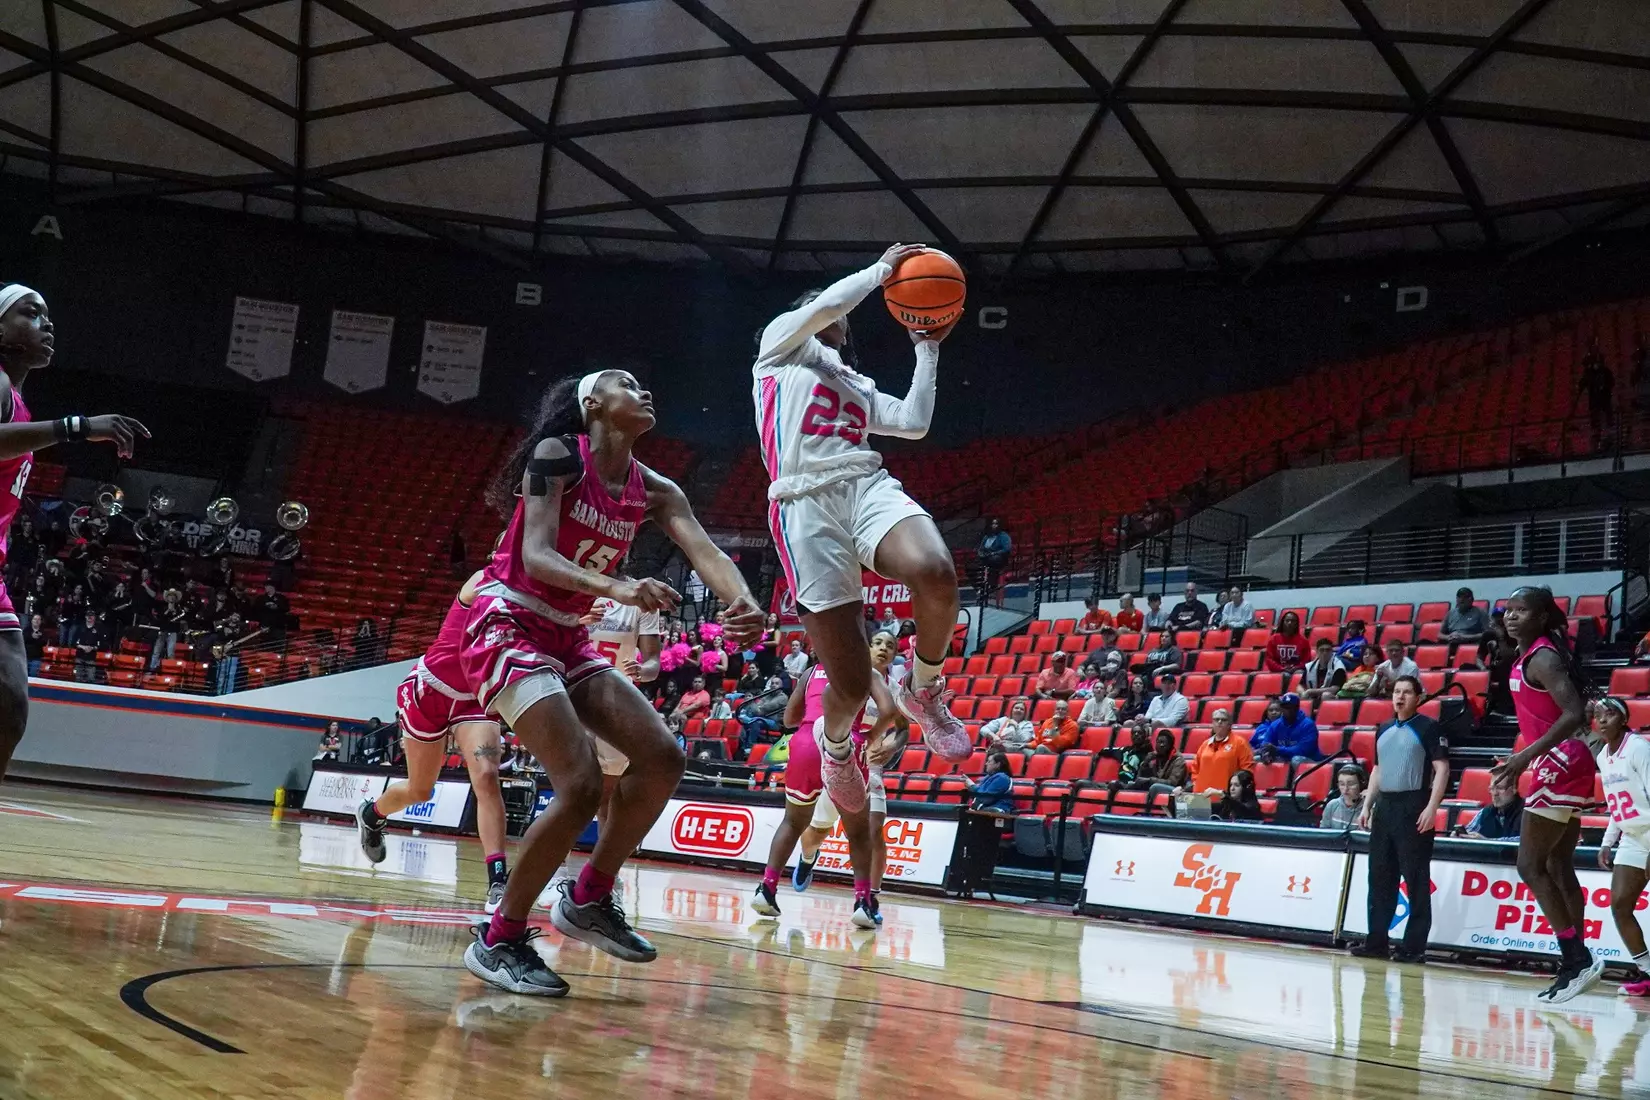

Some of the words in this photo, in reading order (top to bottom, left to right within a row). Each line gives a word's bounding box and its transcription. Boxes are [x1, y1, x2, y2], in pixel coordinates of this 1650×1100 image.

[31, 215, 63, 240] A
[516, 282, 542, 306] B
[1396, 286, 1428, 312] D
[900, 310, 955, 326] Wilson
[978, 306, 1008, 329] C
[801, 383, 867, 446] 22
[569, 498, 598, 530] SAM
[597, 513, 636, 542] HOUSTO
[572, 539, 620, 575] 15
[882, 584, 911, 603] CRE
[405, 803, 436, 818] LIGHT
[1607, 791, 1640, 822] 22
[900, 850, 920, 861] INC.
[1494, 904, 1603, 940] Piza
[1471, 933, 1500, 945] Order
[1501, 937, 1535, 949] Online
